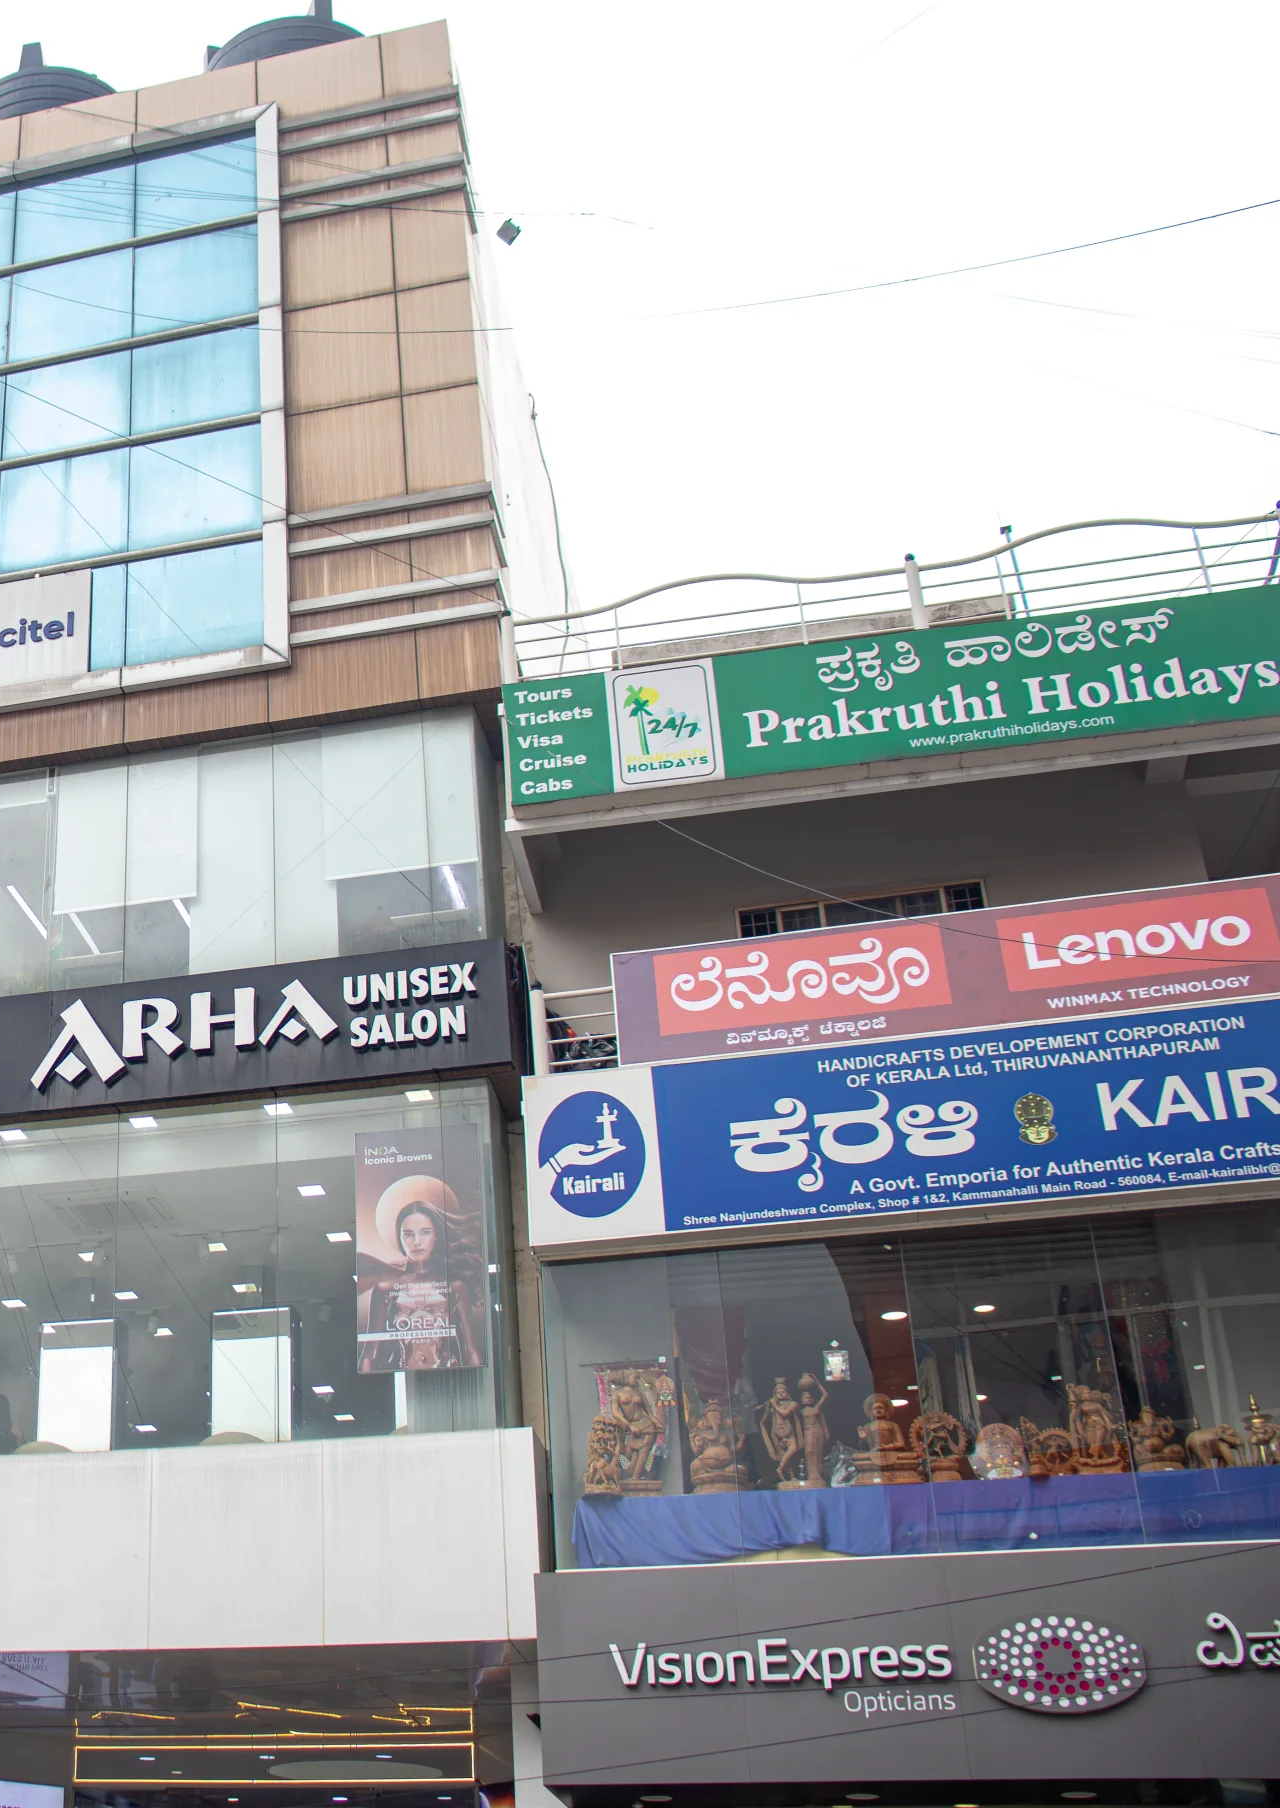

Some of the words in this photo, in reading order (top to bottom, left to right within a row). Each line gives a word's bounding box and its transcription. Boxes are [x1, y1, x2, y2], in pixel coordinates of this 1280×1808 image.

[816, 640, 920, 692] ಪ್ರಕೃತಿ
[944, 607, 1175, 668] ಹಾಲಿಡೇಸ್
[514, 687, 573, 705] Tours
[742, 680, 1007, 748] Prakruthi
[1022, 657, 1280, 715] Holidays
[516, 705, 594, 727] Tickets
[647, 715, 700, 739] 24/7
[909, 714, 1115, 748] www.prakruthiholidays.com
[517, 733, 564, 749] Visa
[519, 753, 587, 773] Cruise
[520, 778, 573, 795] Cabs
[1022, 915, 1251, 970] Lenovo
[342, 961, 477, 1006] UNISEX
[1047, 990, 1124, 1009] WINMAX
[1127, 975, 1252, 1000] TECHNOLOGY
[30, 978, 341, 1092] ARHA
[349, 1004, 468, 1050] SALON
[817, 1048, 945, 1074] HANDICRAFTS
[950, 1031, 1099, 1060] DEVELOPEMENT
[1105, 1015, 1246, 1042] CORPORATION
[846, 1073, 871, 1088] OF
[876, 1067, 951, 1086] KERALA
[954, 1062, 988, 1078] Ltd,
[992, 1037, 1220, 1074] THIRUVANANTHAPURAM
[1096, 1066, 1280, 1132] KAIR
[364, 1155, 395, 1166] Iconic
[396, 1152, 433, 1163] Browns
[729, 1089, 979, 1193] ಕೈರಳಿ
[563, 1171, 625, 1196] Kairali
[850, 1179, 865, 1195] A
[869, 1175, 920, 1193] Govt.
[925, 1167, 1008, 1189] Emporia
[1013, 1164, 1040, 1180] for
[1046, 1154, 1143, 1177] Authentic
[1147, 1147, 1215, 1168] Kerala
[1219, 1141, 1280, 1161] Crafts
[683, 1213, 717, 1226] Shree
[719, 1204, 817, 1223] Nanjundeshwara
[819, 1200, 875, 1214] Complex,
[878, 1197, 910, 1211] Shop
[912, 1195, 920, 1206] #
[924, 1192, 950, 1205] 1&2,
[952, 1184, 1039, 1202] Kammanahalli
[1041, 1182, 1071, 1194] Main
[1074, 1178, 1107, 1191] Road
[1117, 1173, 1166, 1187] 560084,
[393, 1282, 407, 1290] Get
[843, 1690, 956, 1717] Opticians
